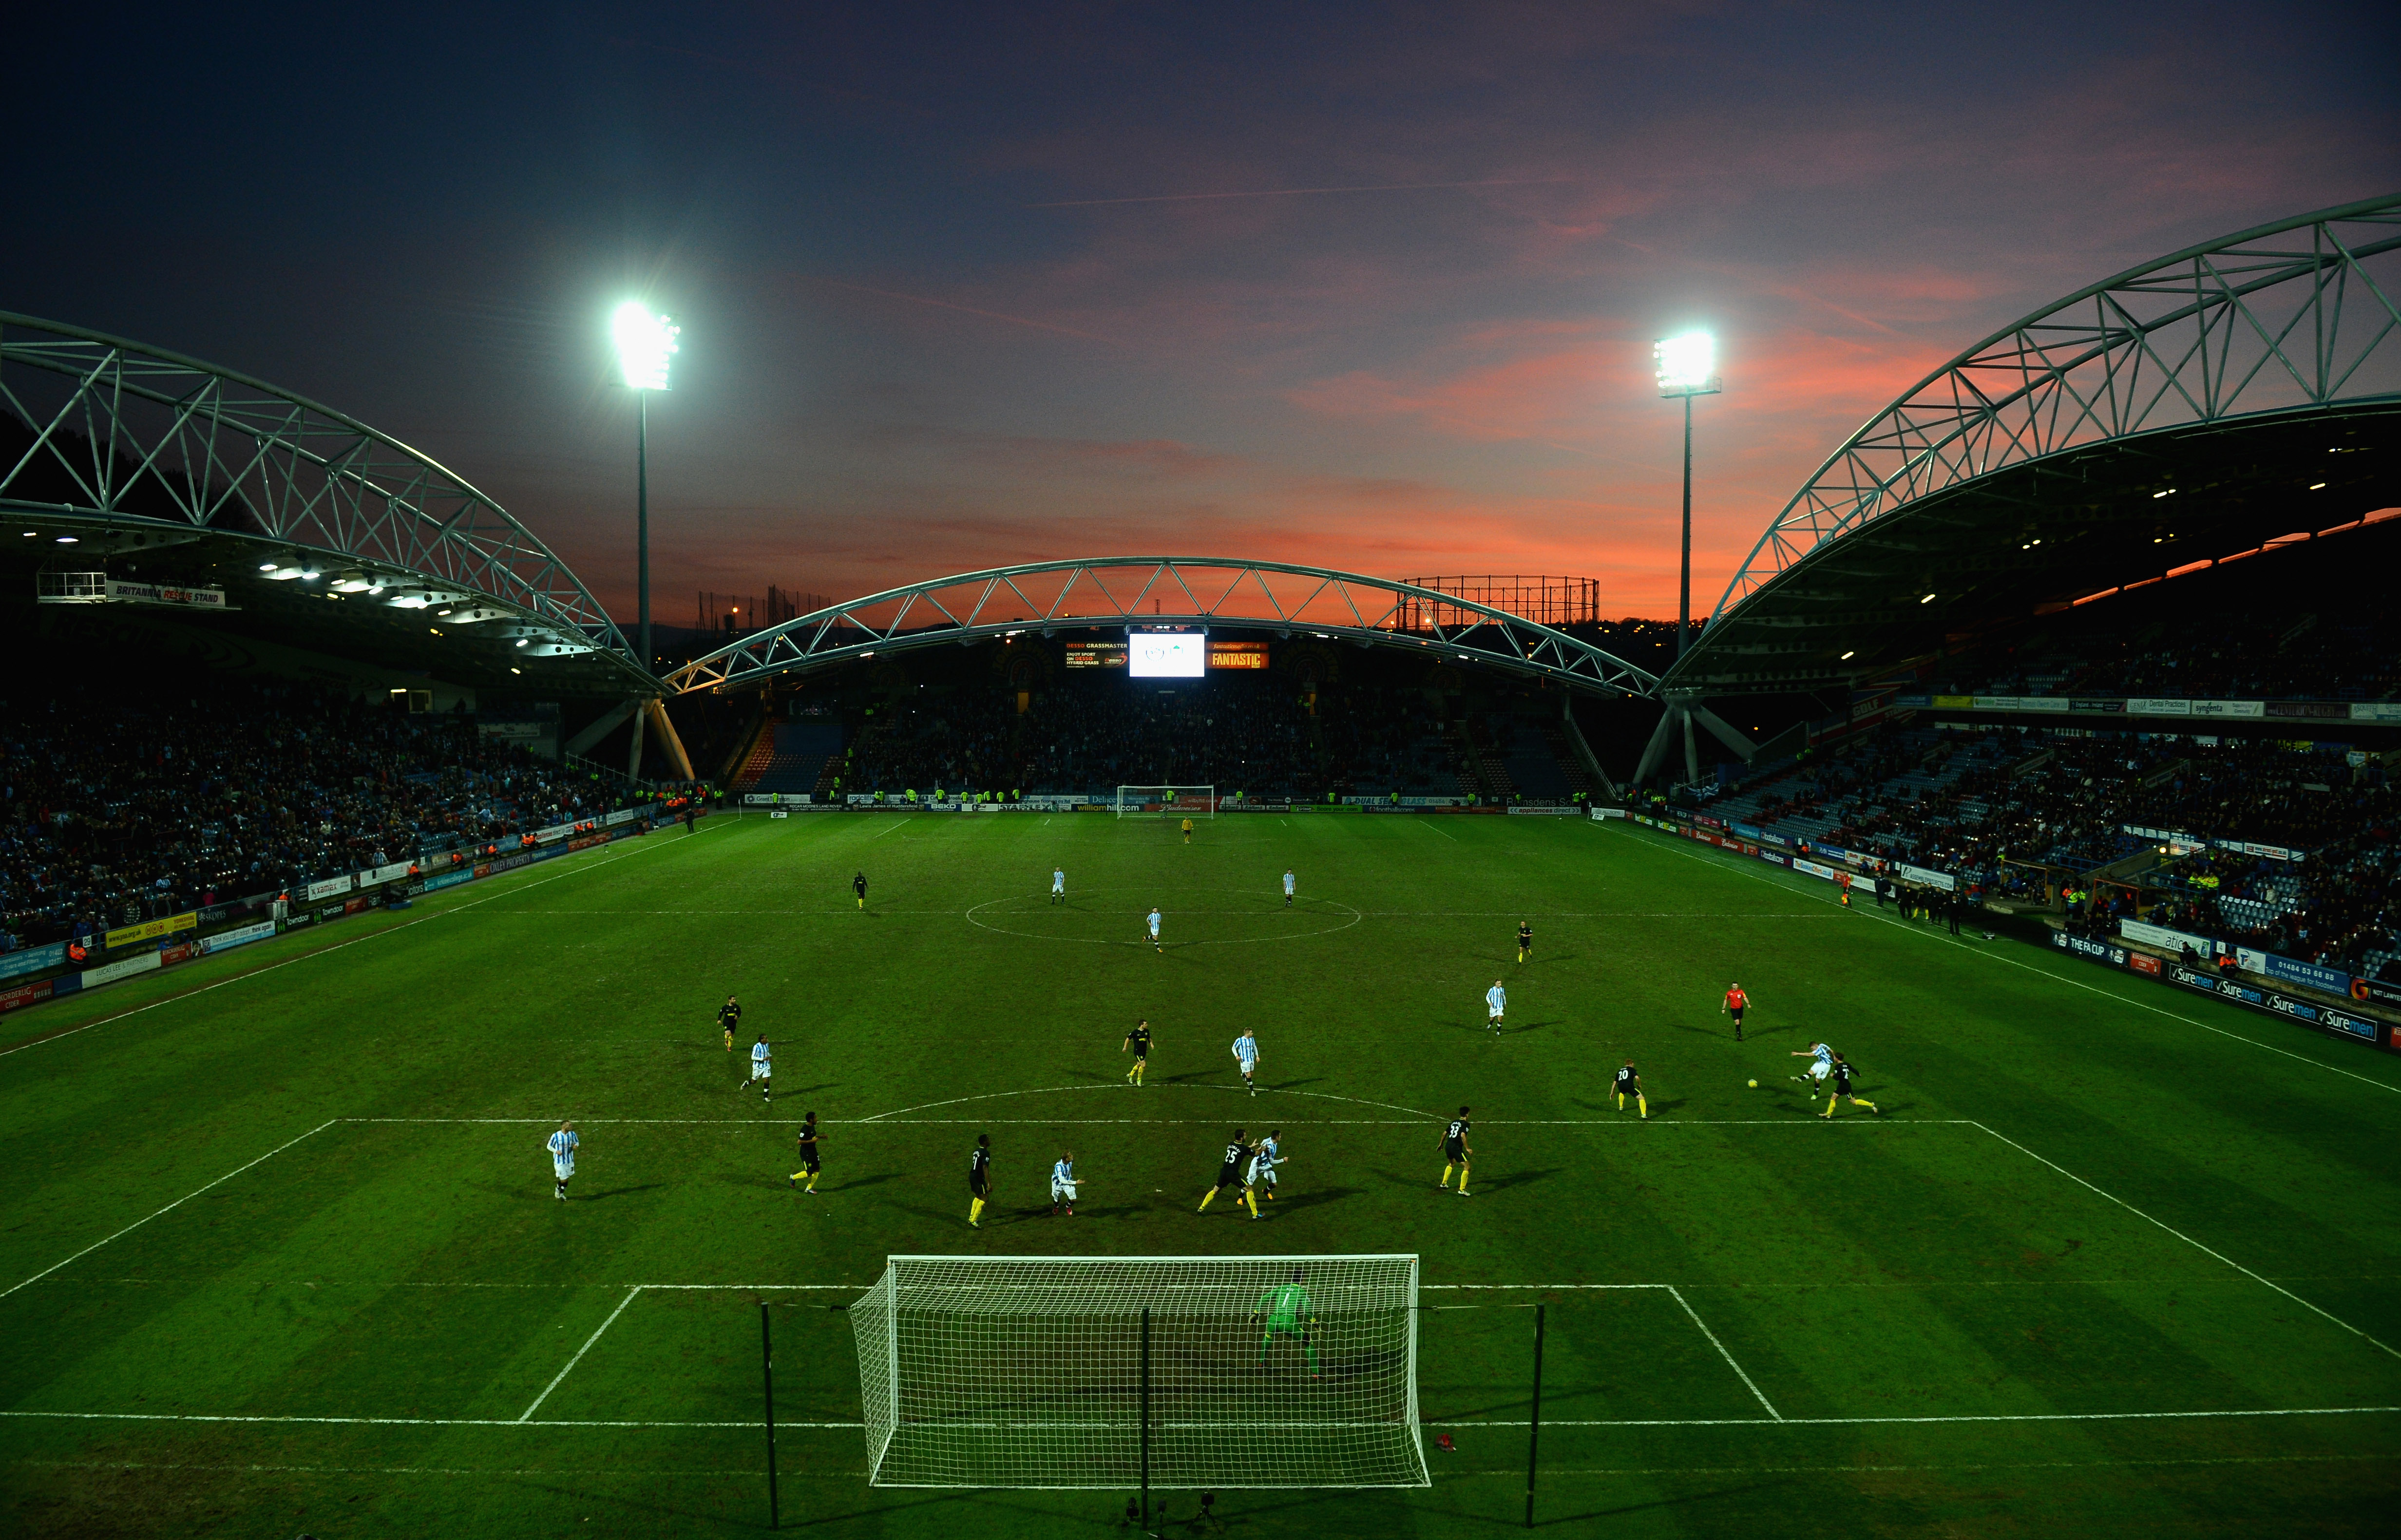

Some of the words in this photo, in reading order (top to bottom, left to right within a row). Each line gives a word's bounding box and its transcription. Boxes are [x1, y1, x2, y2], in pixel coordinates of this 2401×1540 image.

[116, 585, 161, 598] BRITANNIA
[164, 590, 192, 601] RESCUE
[194, 593, 218, 603] STAND
[1213, 653, 1260, 665] FANTASTIC
[1853, 699, 1879, 717] GOLF
[2196, 702, 2223, 714] syngenta
[490, 859, 505, 874] OXLEY
[506, 854, 531, 868] PROPERTY
[317, 883, 337, 894] xamax
[205, 909, 227, 922] SKOPES
[323, 905, 344, 916] Towndoor
[286, 913, 310, 926] Towndoor
[83, 937, 91, 946] 29
[2071, 938, 2083, 950] THE
[2083, 941, 2091, 953] FA
[2092, 944, 2104, 956] CUP
[96, 966, 112, 977] LUCAS
[127, 956, 149, 968] PARTNERS
[2278, 961, 2299, 972] 01484
[2302, 967, 2311, 975] 53
[2313, 970, 2323, 978] 66
[2266, 967, 2274, 975] Top
[2289, 973, 2306, 985] league
[5, 1000, 20, 1009] CIDER
[1618, 1070, 1629, 1082] 20
[1448, 1125, 1459, 1138] 33
[1225, 1149, 1238, 1164] 25
[1282, 1292, 1290, 1307] 1
